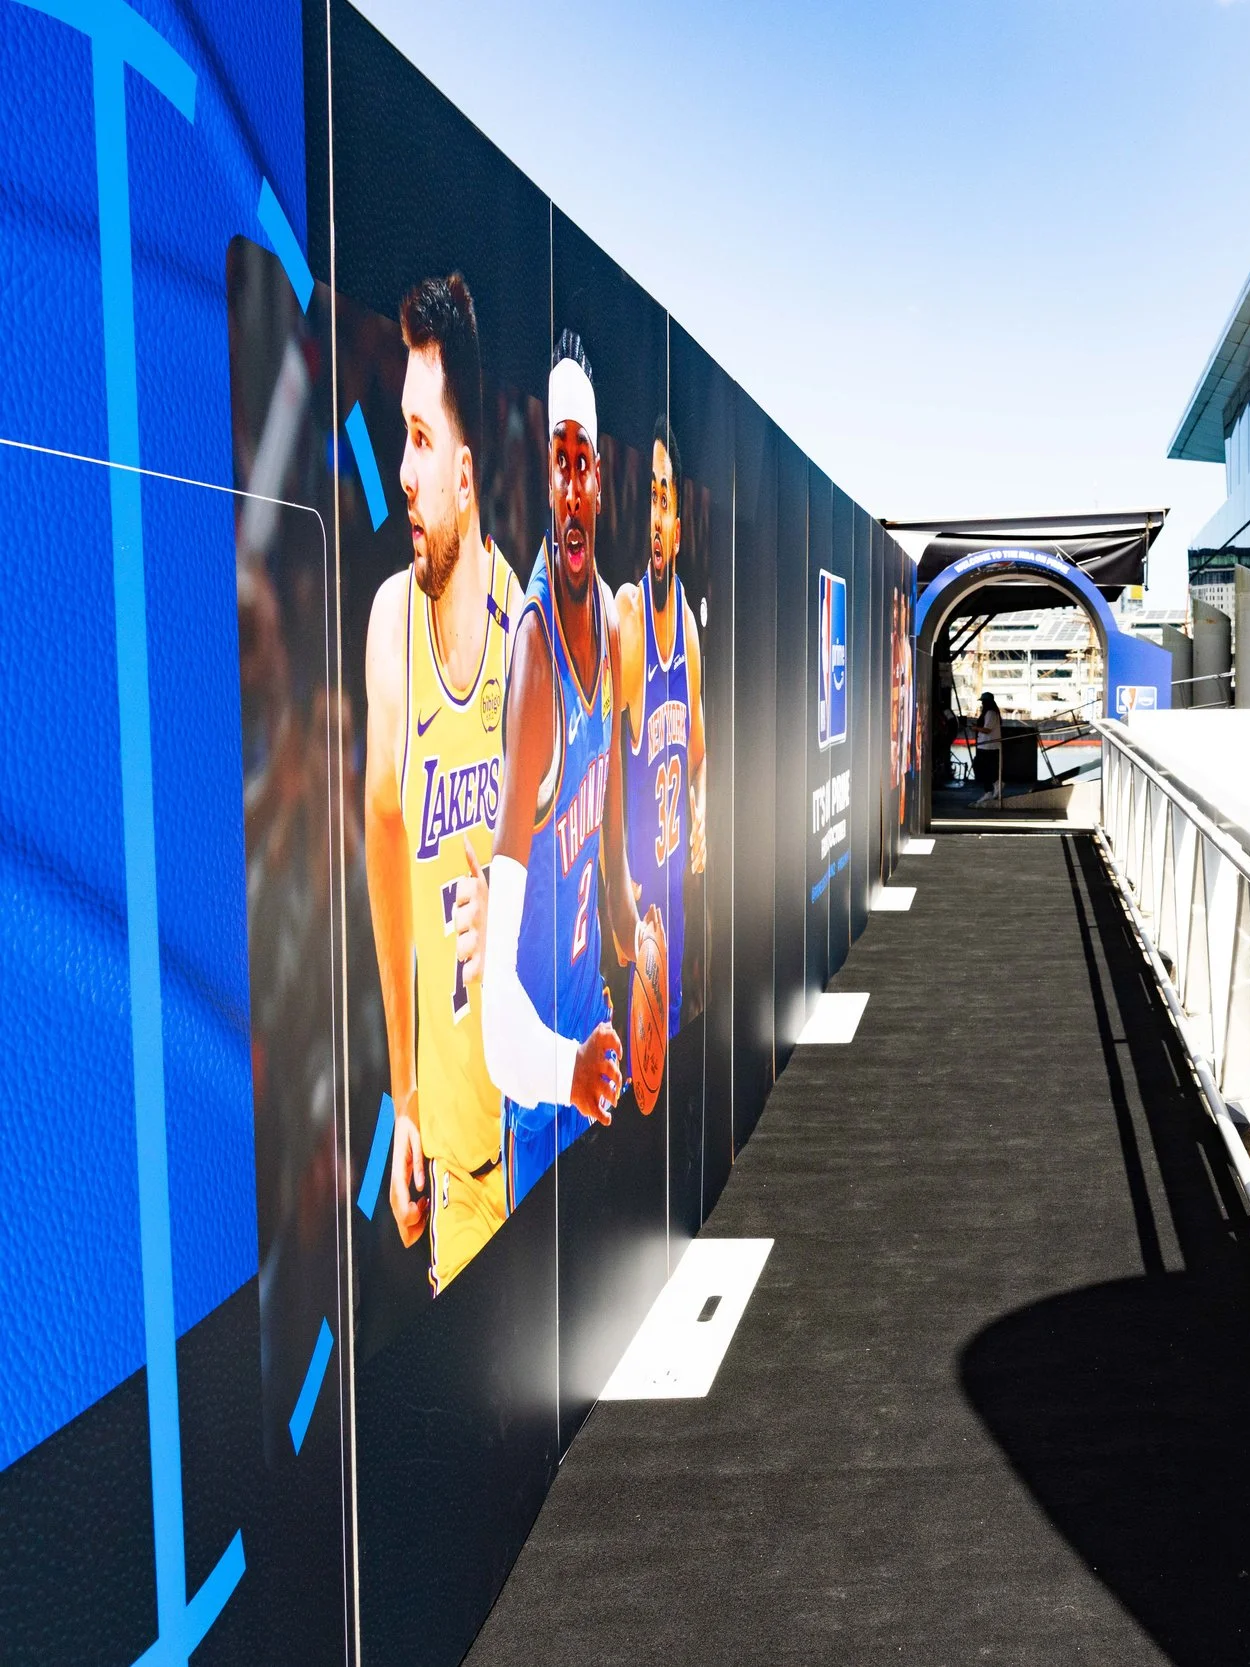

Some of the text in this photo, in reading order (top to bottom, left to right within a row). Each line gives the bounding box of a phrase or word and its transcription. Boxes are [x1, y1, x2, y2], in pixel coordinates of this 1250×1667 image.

[991, 551, 1002, 560] TO
[1003, 550, 1018, 559] THE
[416, 755, 500, 861] LAKERS
[654, 754, 681, 868] 32
[570, 861, 593, 967] 2
